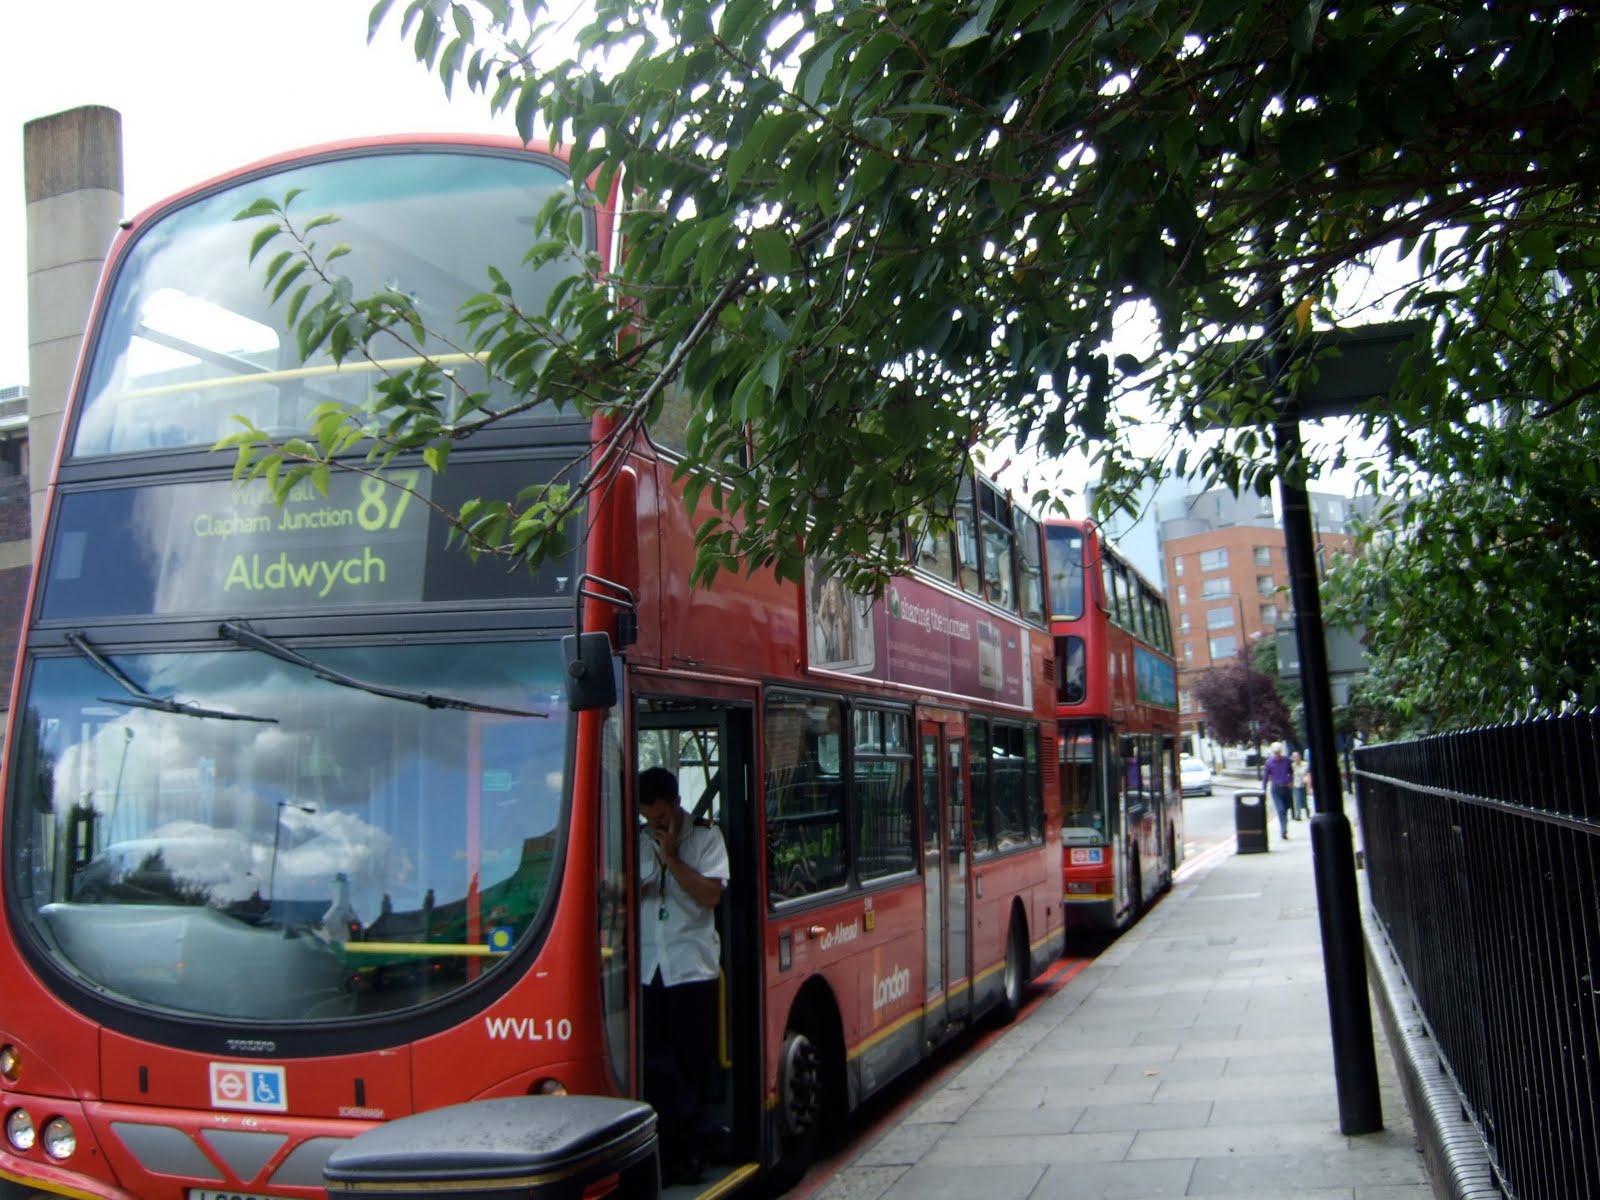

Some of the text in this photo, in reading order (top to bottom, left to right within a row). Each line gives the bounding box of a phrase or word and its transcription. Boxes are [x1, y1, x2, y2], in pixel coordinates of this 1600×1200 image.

[357, 470, 421, 531] 87
[194, 507, 352, 539] Clapham Junction
[224, 547, 386, 597] Aldwych
[901, 597, 931, 633] sharing
[873, 963, 911, 1010] London
[485, 1017, 572, 1041] WVL10
[338, 1106, 385, 1119] SCREENWASH
